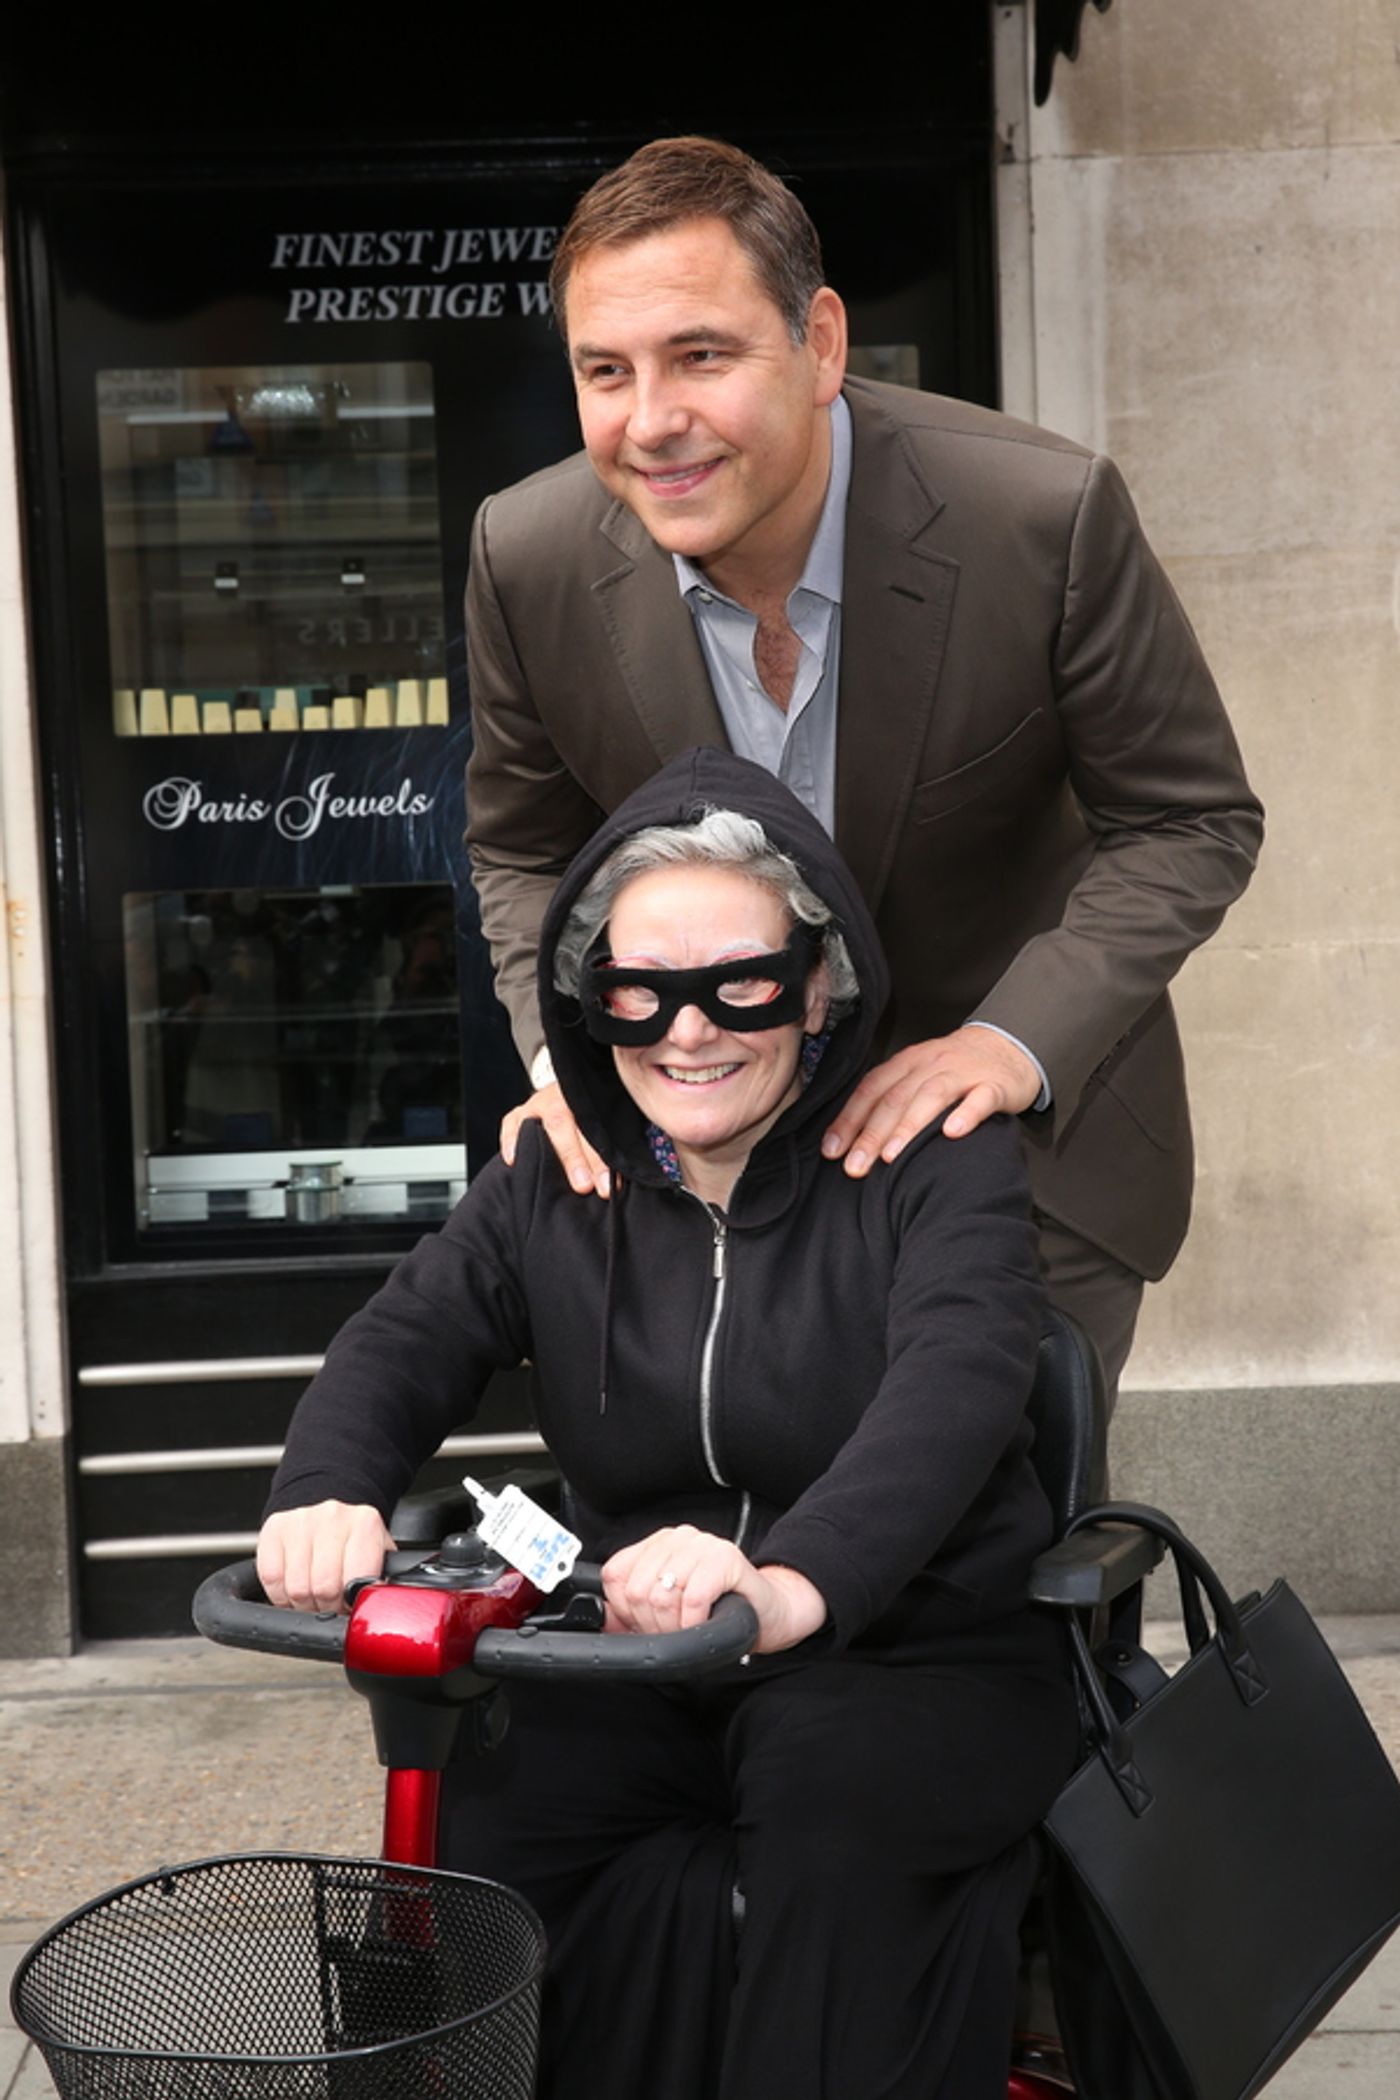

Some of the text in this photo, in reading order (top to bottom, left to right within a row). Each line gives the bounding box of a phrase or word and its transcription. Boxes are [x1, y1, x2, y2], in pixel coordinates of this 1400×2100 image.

[270, 226, 563, 272] FINEST JEWE
[285, 282, 505, 323] PRESTIGE
[143, 772, 434, 841] Paris Jewels
